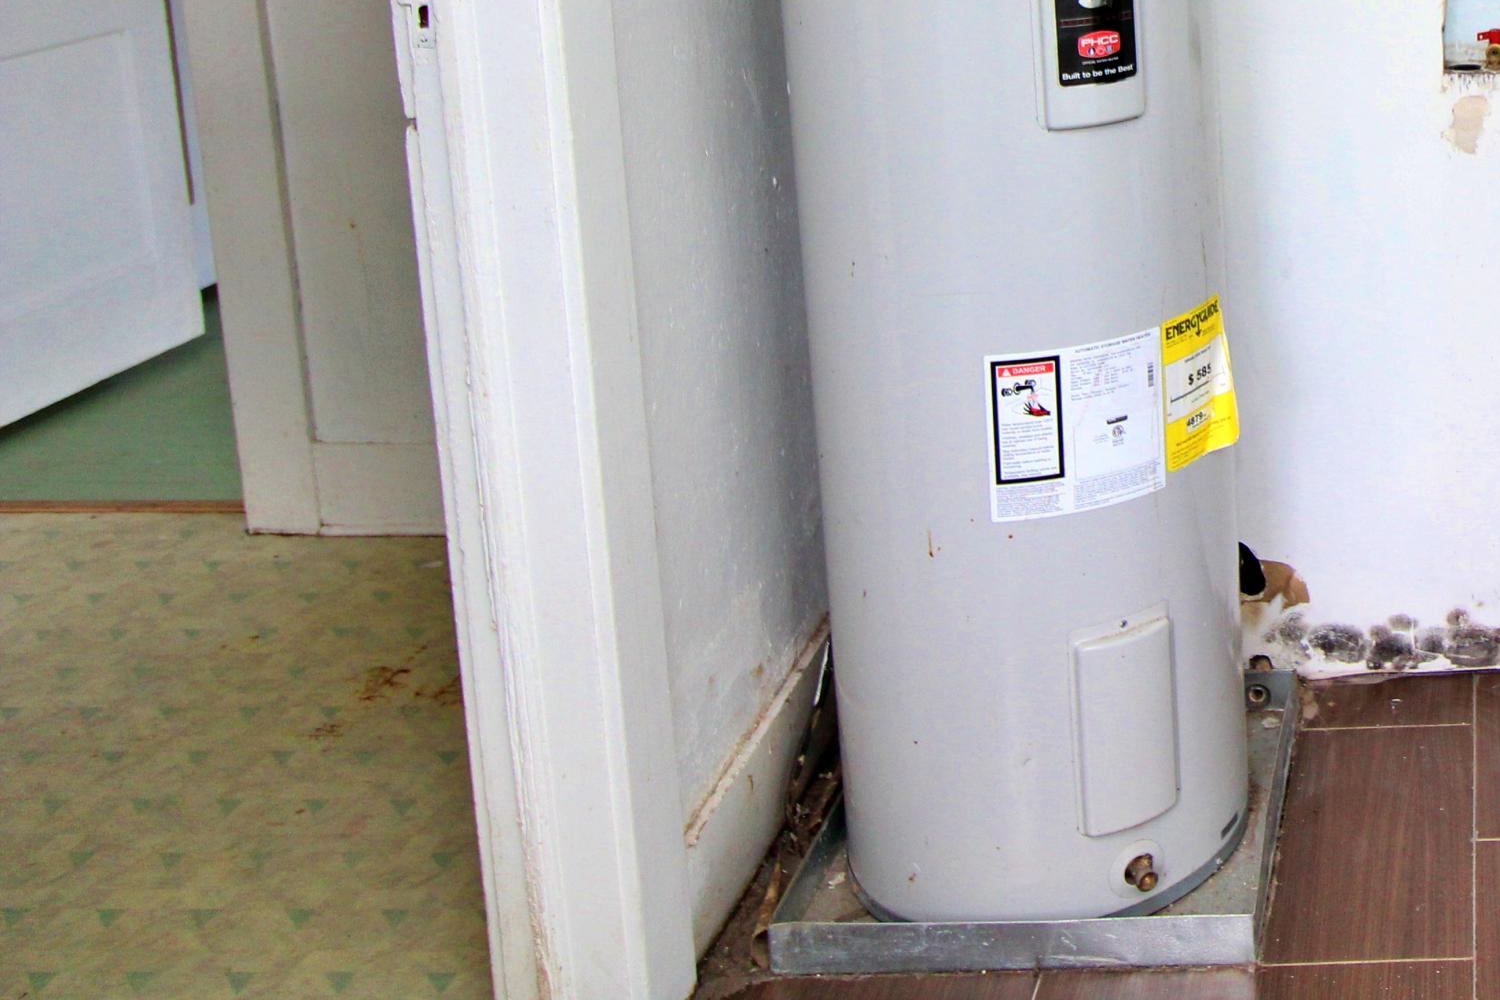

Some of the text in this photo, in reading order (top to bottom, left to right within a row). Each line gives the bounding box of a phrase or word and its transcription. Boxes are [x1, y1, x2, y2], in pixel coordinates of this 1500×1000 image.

[1081, 34, 1119, 48] PHCC
[1062, 72, 1080, 81] Built
[1104, 67, 1117, 75] the
[1117, 64, 1134, 73] Best
[1012, 365, 1046, 375] DANGER
[1196, 362, 1212, 380] 585
